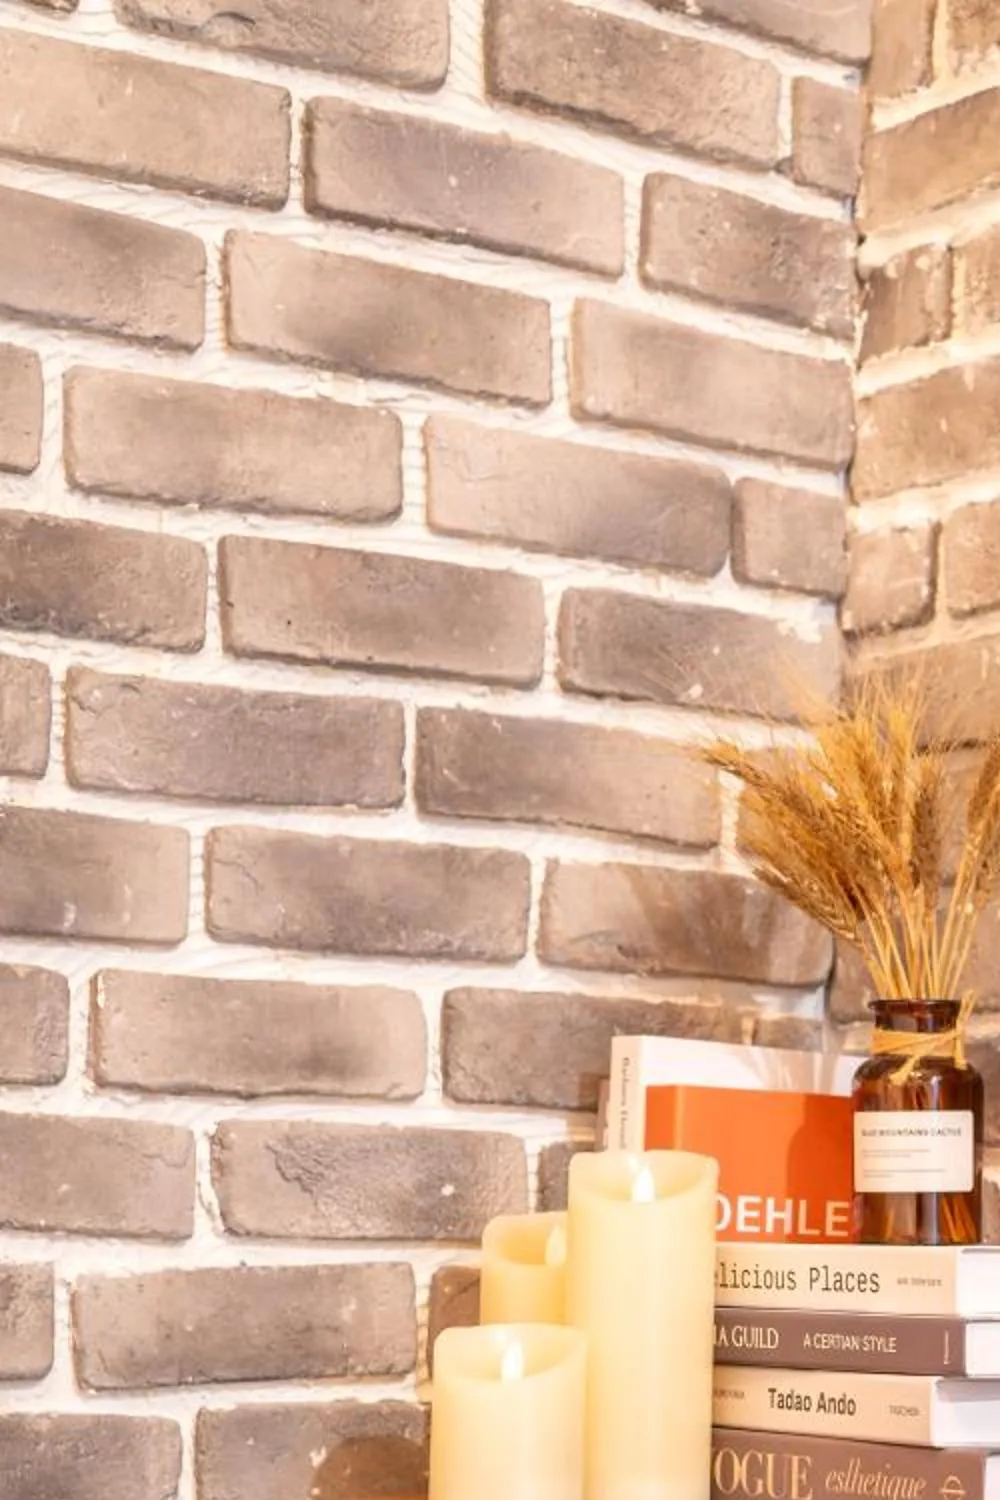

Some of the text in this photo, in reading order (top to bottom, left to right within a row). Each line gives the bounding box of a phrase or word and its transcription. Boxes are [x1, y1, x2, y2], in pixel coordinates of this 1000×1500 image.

[808, 1264, 881, 1293] Places
[731, 1325, 779, 1349] GUILD
[803, 1332, 812, 1349] A
[862, 1334, 897, 1353] STYLE
[767, 1387, 813, 1413] Tadao
[815, 1391, 857, 1416] Ando
